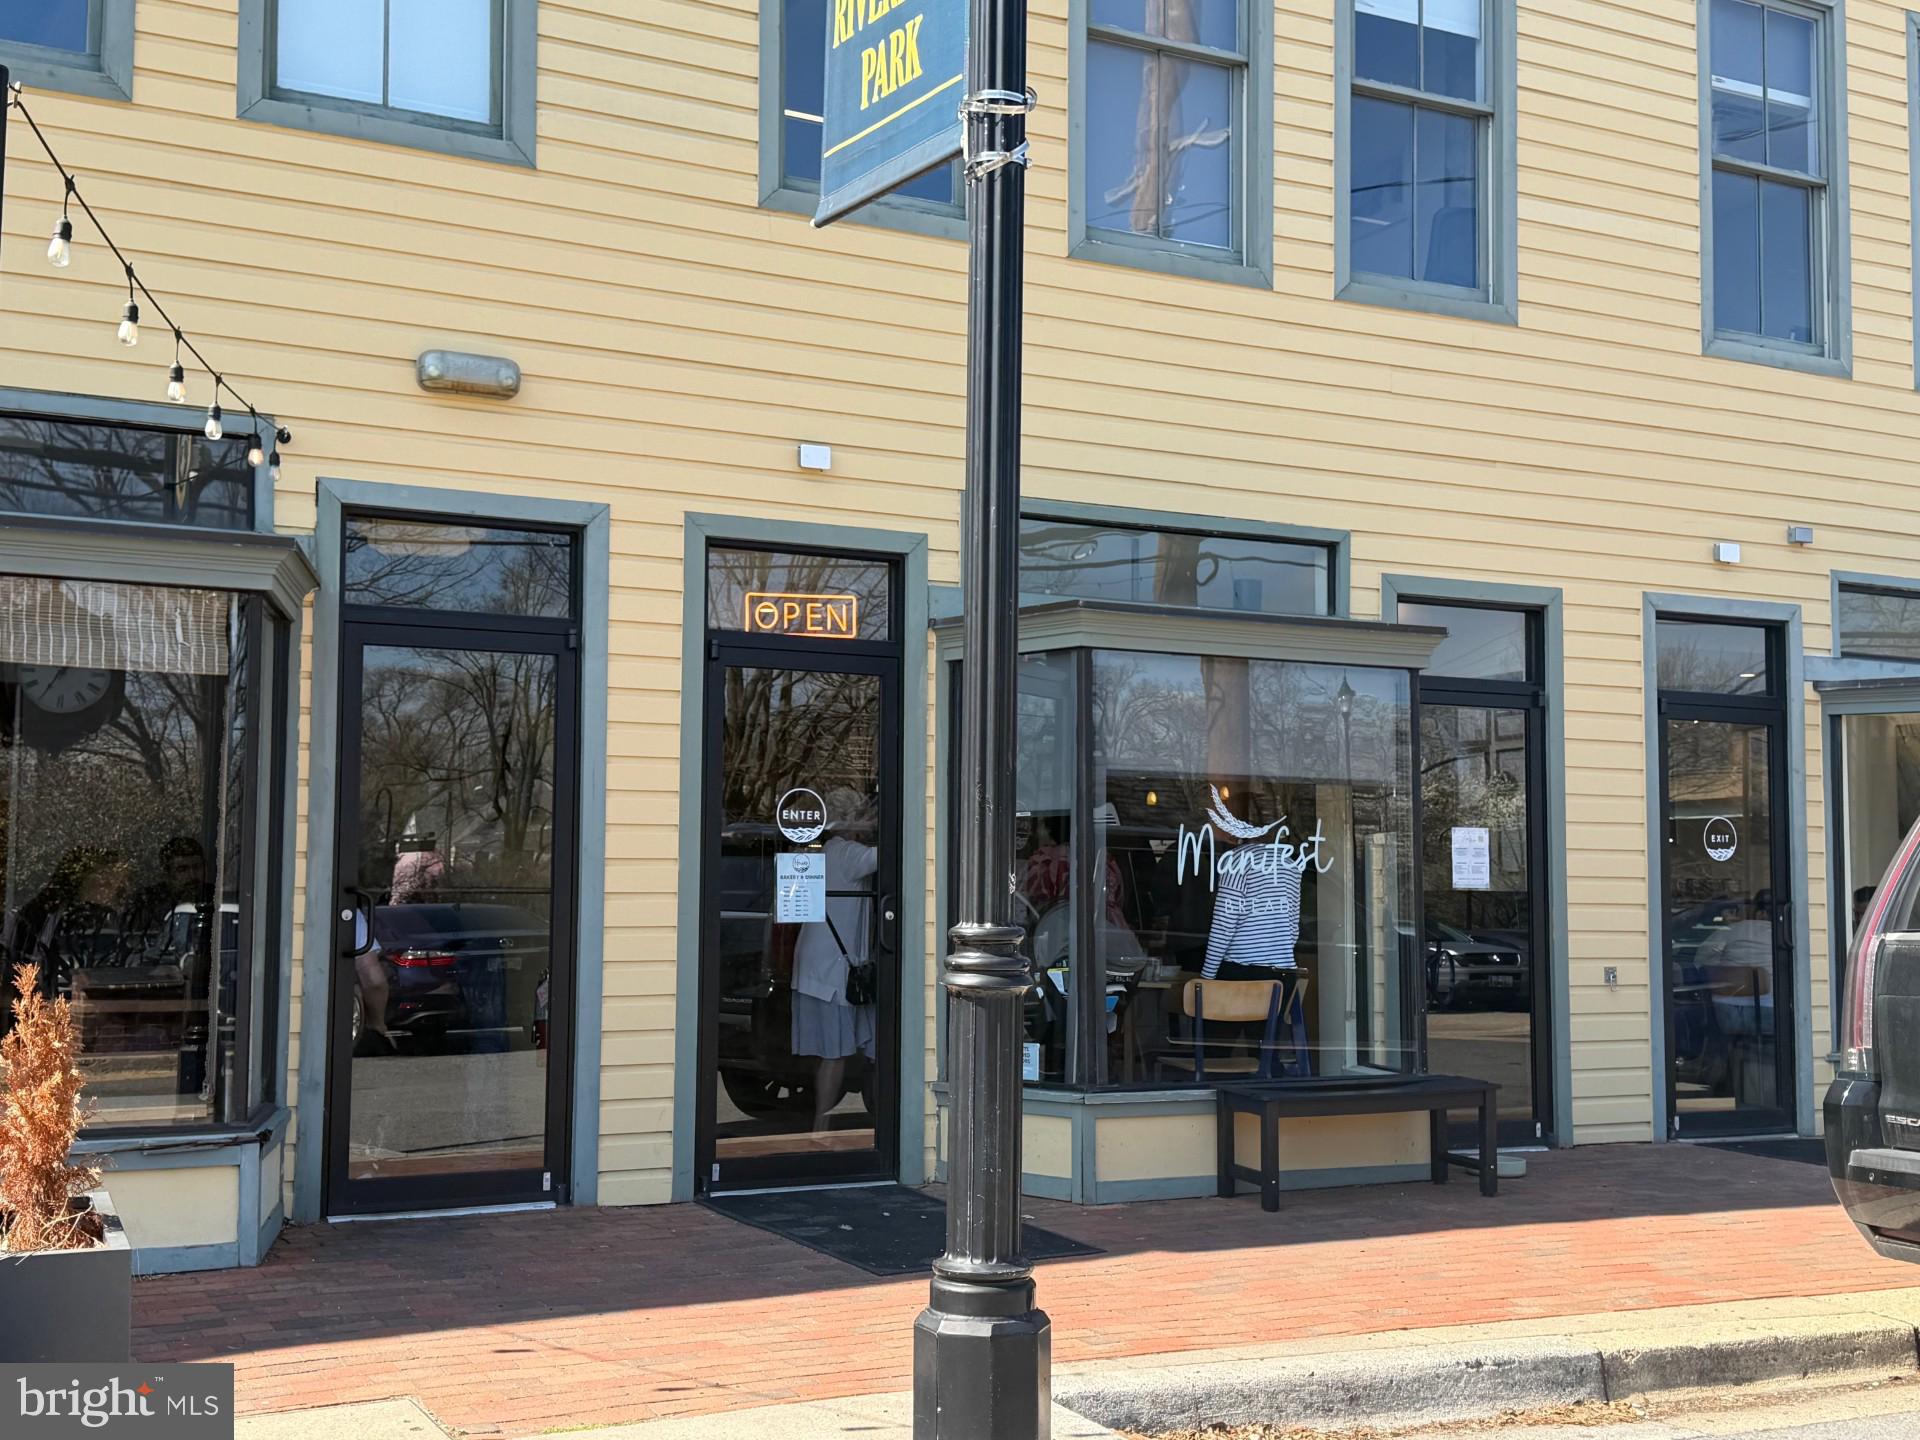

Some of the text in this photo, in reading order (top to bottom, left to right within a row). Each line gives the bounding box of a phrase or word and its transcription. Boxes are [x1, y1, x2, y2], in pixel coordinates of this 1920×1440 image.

[860, 14, 923, 111] PARK
[754, 601, 848, 632] OPEN
[782, 809, 821, 821] ENTER
[1710, 834, 1730, 844] EXIT
[1177, 818, 1335, 893] Manifest
[1224, 897, 1290, 915] BREAD
[1885, 1114, 1920, 1127] ESC
